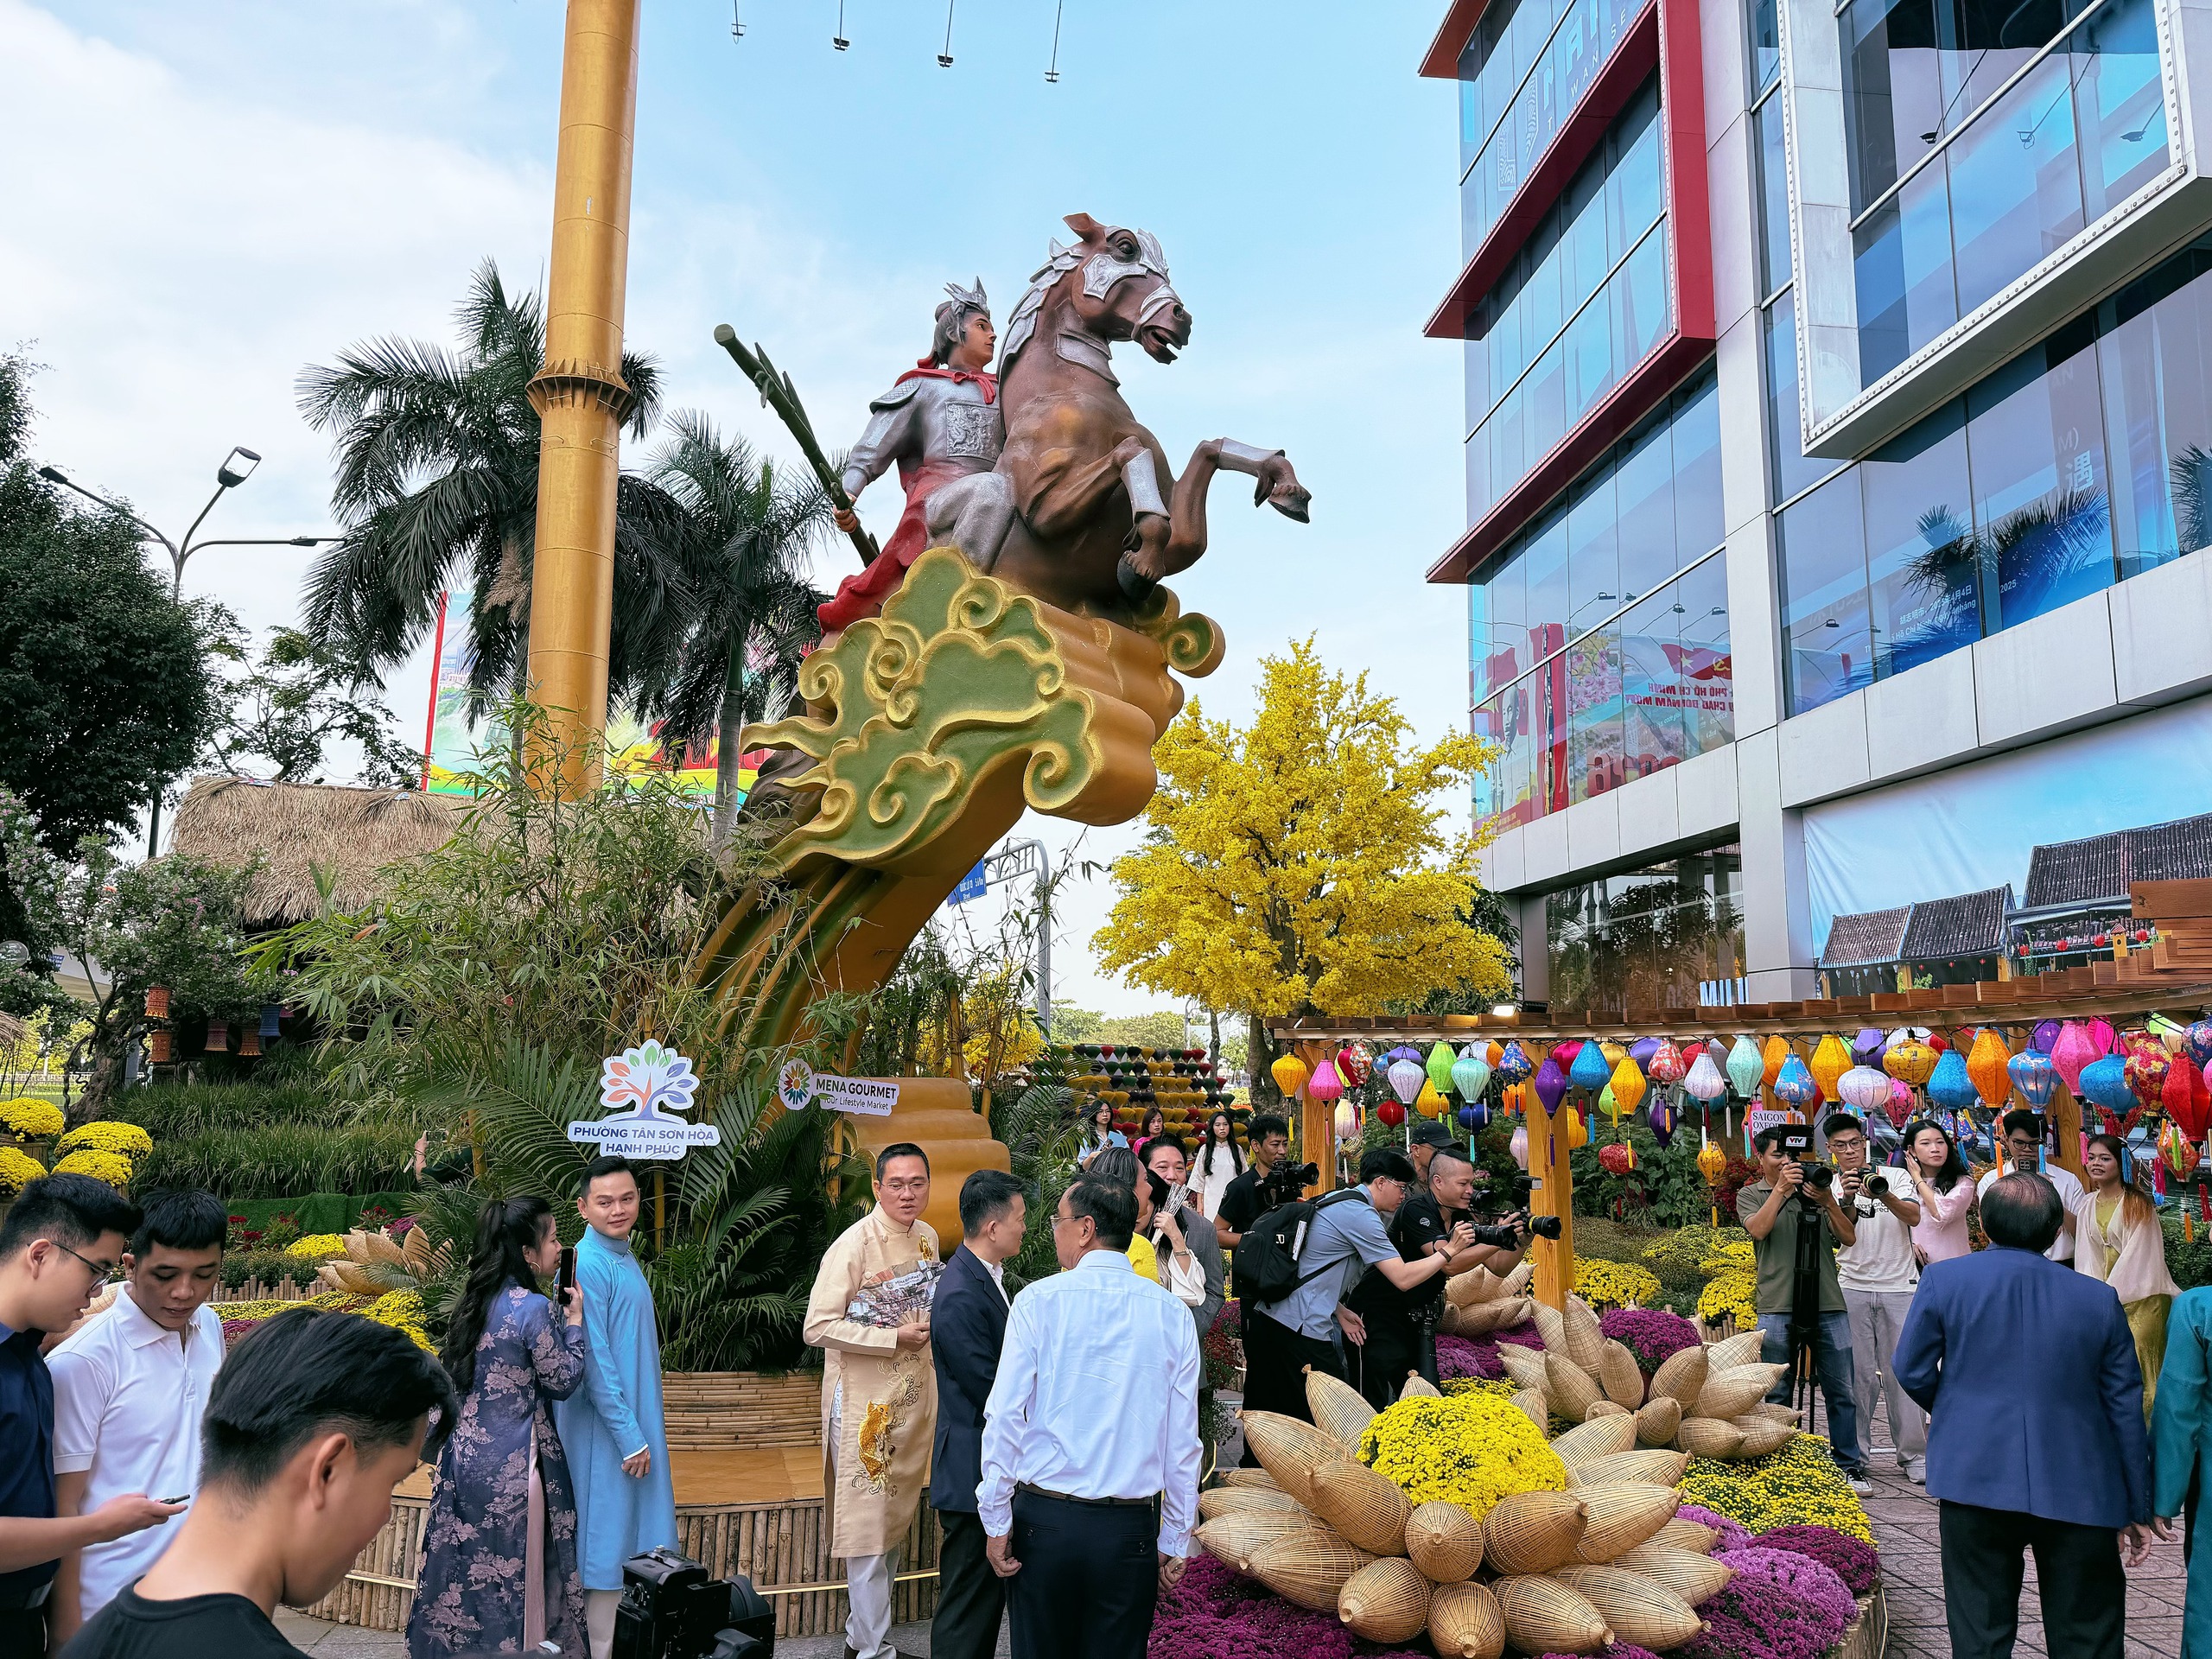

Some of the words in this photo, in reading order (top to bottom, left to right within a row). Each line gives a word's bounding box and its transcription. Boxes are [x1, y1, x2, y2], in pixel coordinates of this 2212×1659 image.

[1999, 579, 2017, 593] 2025
[816, 1078, 847, 1094] MENA
[848, 1083, 897, 1099] GOURMET
[839, 1097, 866, 1109] Lifestyle
[867, 1101, 889, 1110] Market
[1752, 1112, 1786, 1122] SAIGON
[574, 1126, 628, 1138] PHƯỜNG
[632, 1127, 655, 1139] TÂN
[658, 1128, 684, 1140] SƠN
[687, 1128, 715, 1141] HÒA
[606, 1142, 642, 1154] HẠNH
[645, 1142, 681, 1154] PHÚC
